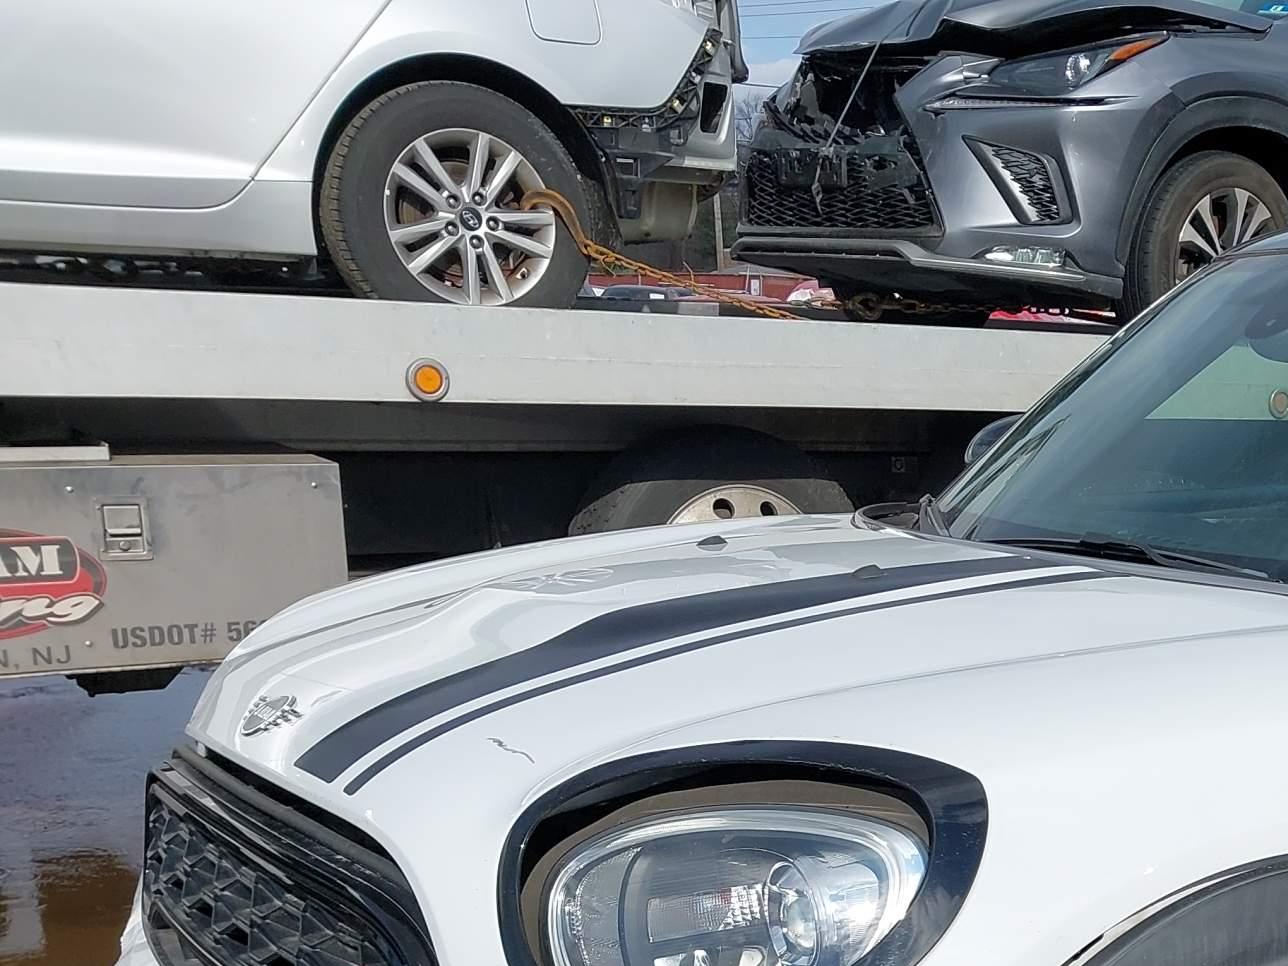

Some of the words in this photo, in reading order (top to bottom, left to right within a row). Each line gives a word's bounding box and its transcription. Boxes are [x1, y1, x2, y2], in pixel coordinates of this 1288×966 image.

[31, 644, 72, 666] NJ
[111, 622, 217, 649] USDOT#
[227, 619, 269, 642] 56
